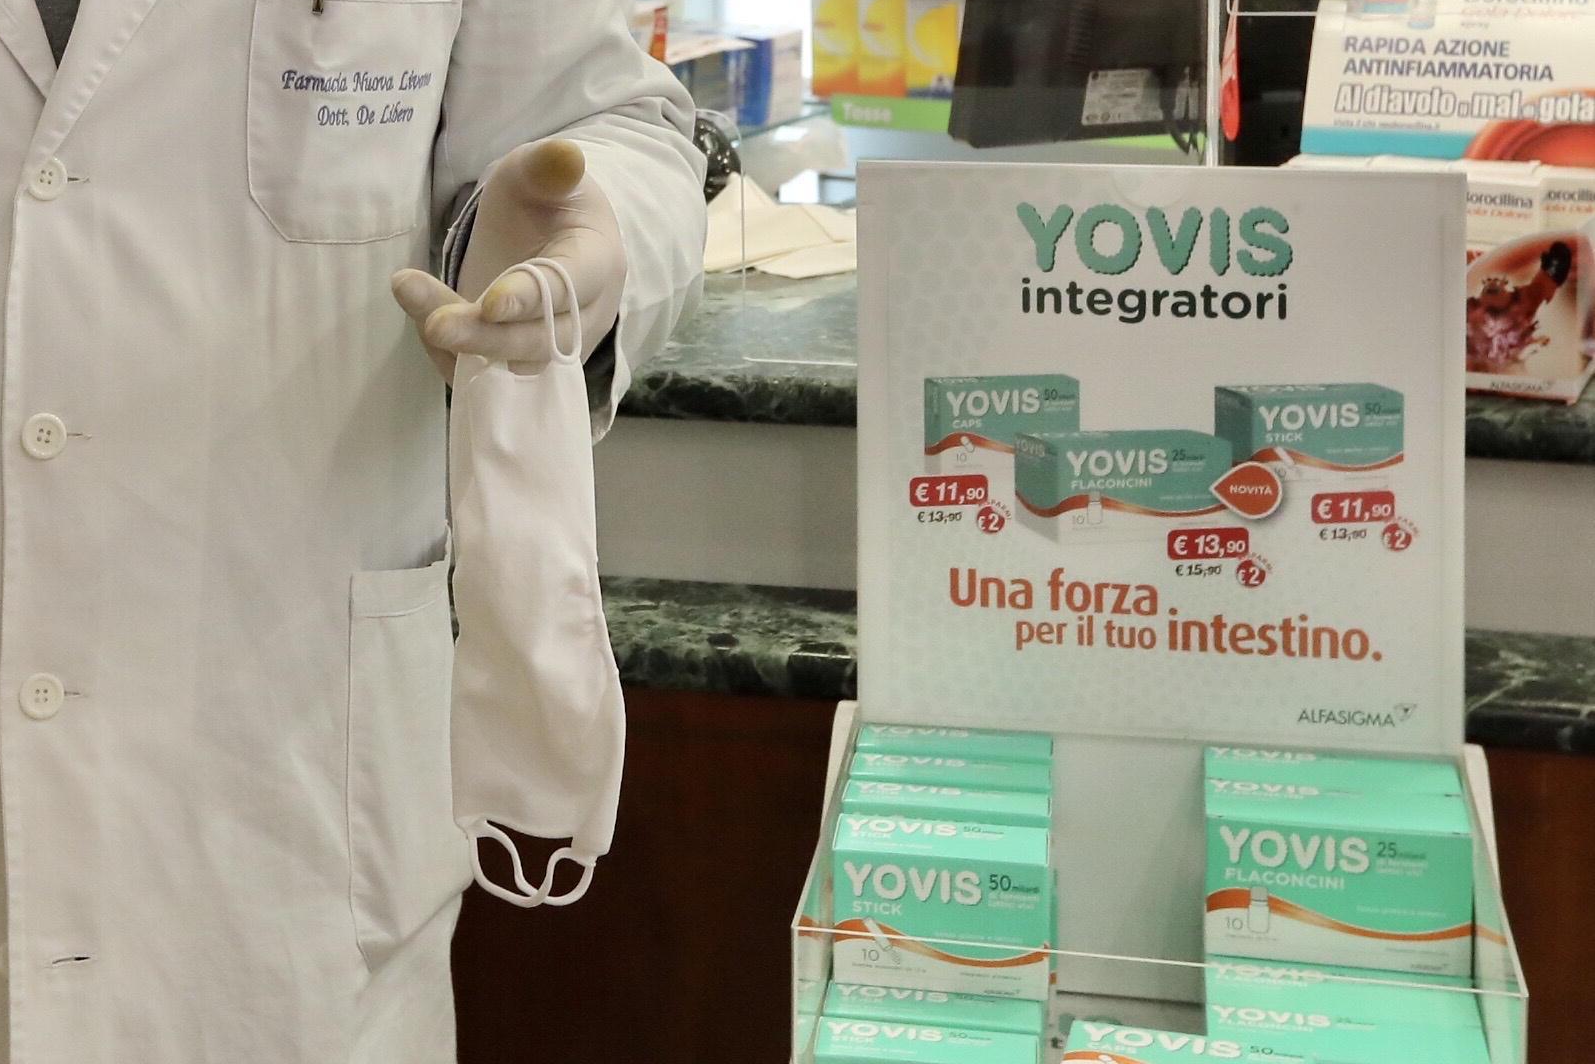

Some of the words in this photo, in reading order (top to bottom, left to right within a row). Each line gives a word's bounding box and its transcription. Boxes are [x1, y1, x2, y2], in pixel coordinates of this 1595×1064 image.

[1344, 35, 1427, 55] RAPIDA
[1433, 38, 1511, 58] AZIONE
[282, 69, 348, 93] Farmacia
[353, 71, 395, 93] Nuova
[1343, 57, 1554, 82] ANTINFIAMMATORIA
[318, 105, 350, 127] Dott.
[357, 104, 376, 126] De
[379, 101, 415, 125] Libero
[842, 101, 893, 123] Tosse
[1333, 81, 1364, 114] Al
[1362, 83, 1457, 117] diavolo
[1470, 88, 1523, 122] mal
[1015, 202, 1294, 277] YOVIS
[1020, 277, 1289, 324] integratori
[946, 387, 1041, 418] YOVIS
[952, 419, 984, 430] CAPS
[1258, 402, 1361, 432] YOVIS
[1265, 432, 1304, 444] STICK
[1065, 447, 1169, 478] YOVIS
[1171, 448, 1187, 462] 25
[1070, 477, 1153, 492] FLACONCINI
[949, 567, 1034, 610] Una
[1048, 567, 1160, 616] forza
[1015, 618, 1067, 651] per
[1076, 615, 1095, 648] il
[1104, 619, 1158, 651] tuo
[1168, 606, 1384, 663] intestino.
[1296, 707, 1396, 728] ALFASIGMA
[846, 816, 958, 837] YOVIS
[1218, 824, 1371, 874] YOVIS
[1376, 841, 1398, 858] 25
[843, 860, 983, 906] YOVIS
[989, 873, 1012, 892] 50
[1224, 867, 1346, 890] FLACONCINI
[852, 900, 903, 916] STICK
[861, 948, 880, 962] 10
[840, 984, 950, 1004] YOVIS
[1211, 1003, 1332, 1028] YOVIS
[827, 1020, 944, 1043] YOVIS
[1084, 1022, 1243, 1059] YOVIS
